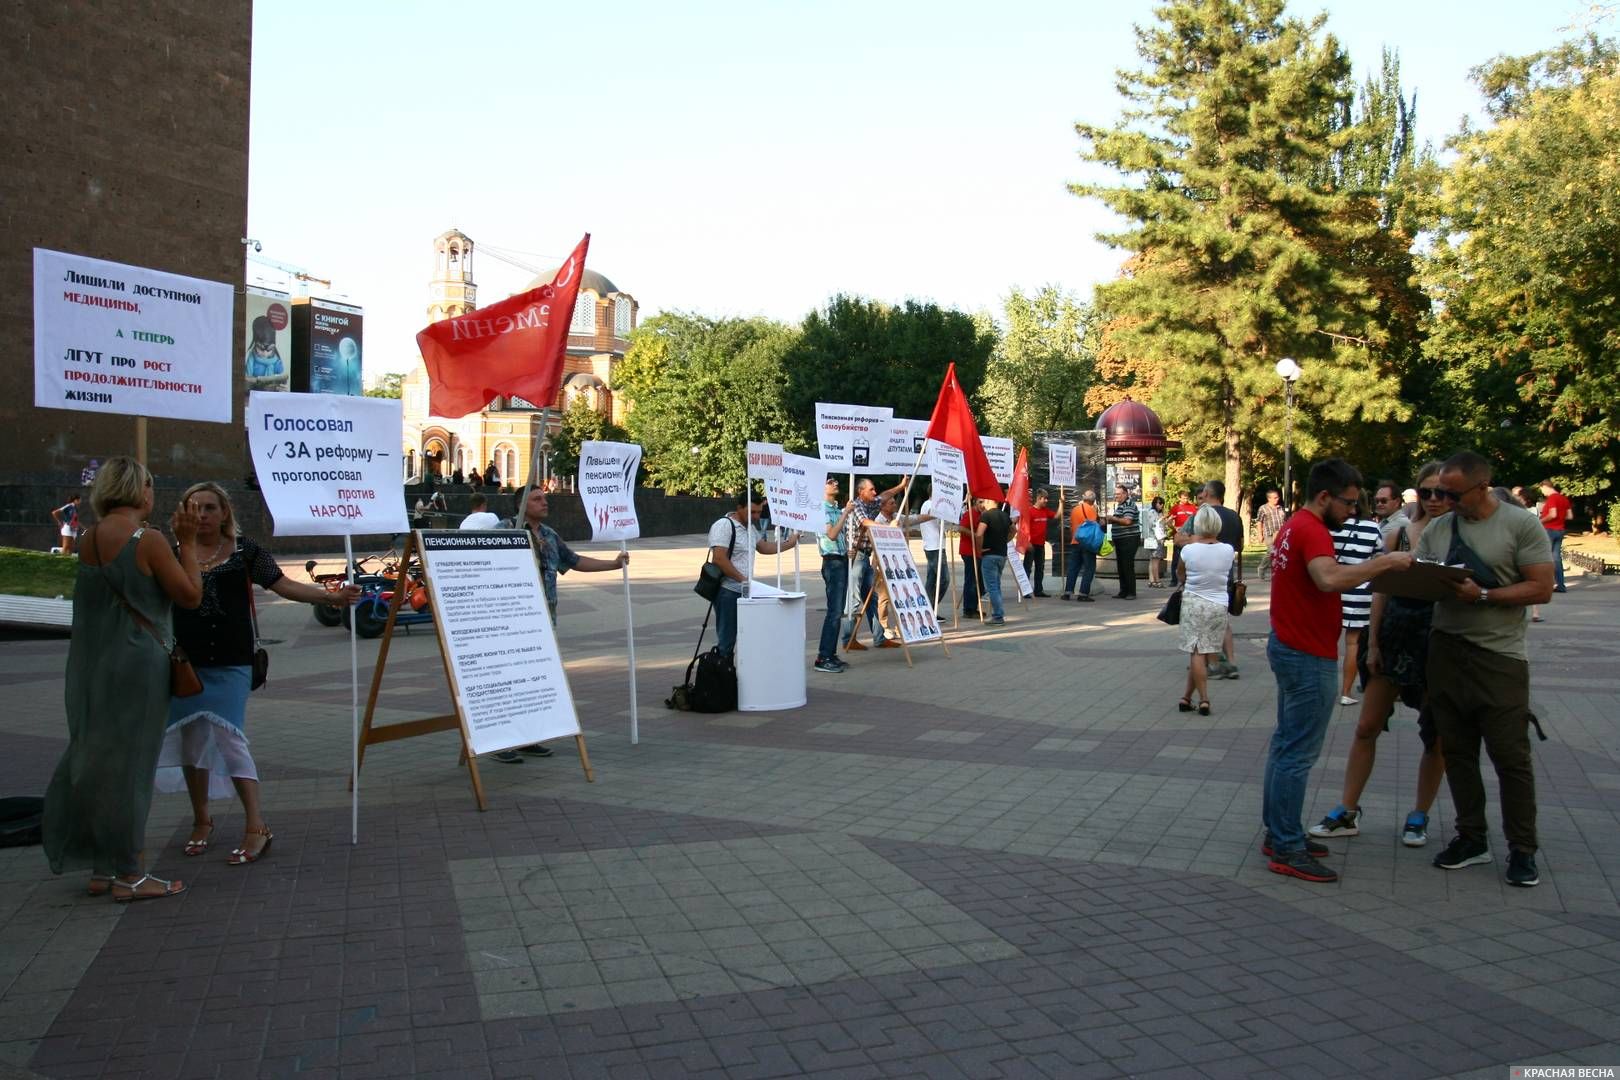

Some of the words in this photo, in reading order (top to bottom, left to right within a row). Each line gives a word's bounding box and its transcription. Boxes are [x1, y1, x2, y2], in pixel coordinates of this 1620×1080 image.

[64, 292, 141, 314] МЕДИЦИНЫ,
[321, 314, 349, 326] КНИГОЙ
[116, 328, 123, 338] А
[132, 330, 175, 345] ТЕПЕРЬ
[64, 348, 103, 363] ЛГУТ
[111, 356, 136, 368] ПРО
[144, 360, 172, 372] РОСТ
[64, 370, 202, 394] ПРОДОЛЖИТЕЛЬНОСТИ
[65, 390, 112, 404] ЖИЗНИ
[264, 413, 353, 432] Голосовал
[284, 441, 311, 459] ЗА
[316, 444, 373, 462] реформу
[272, 470, 362, 485] проголосовал
[338, 488, 375, 500] против
[310, 504, 363, 519] НАРОДА
[425, 537, 477, 546] ПЕНСИОННАЯ
[477, 537, 511, 546] РЕФОРМА
[512, 537, 528, 545] ЭТО:
